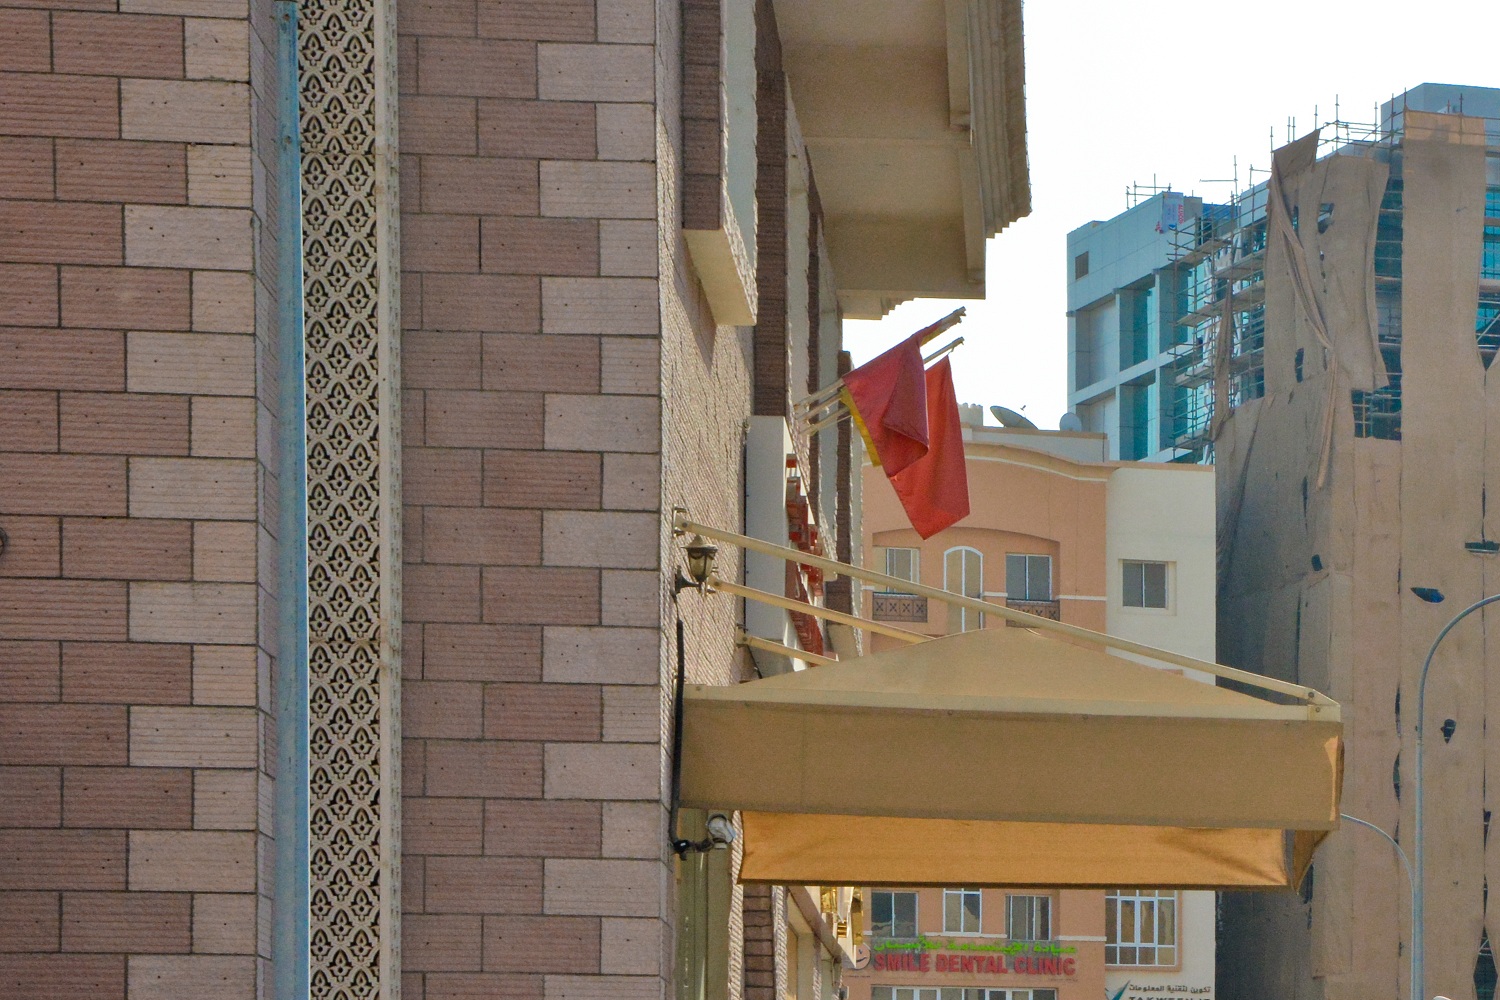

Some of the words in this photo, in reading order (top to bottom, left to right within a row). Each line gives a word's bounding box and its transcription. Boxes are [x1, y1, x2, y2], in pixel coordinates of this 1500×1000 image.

[874, 953, 931, 973] SMILE
[936, 954, 1008, 975] DENTAL
[1014, 956, 1076, 976] CLINIC
